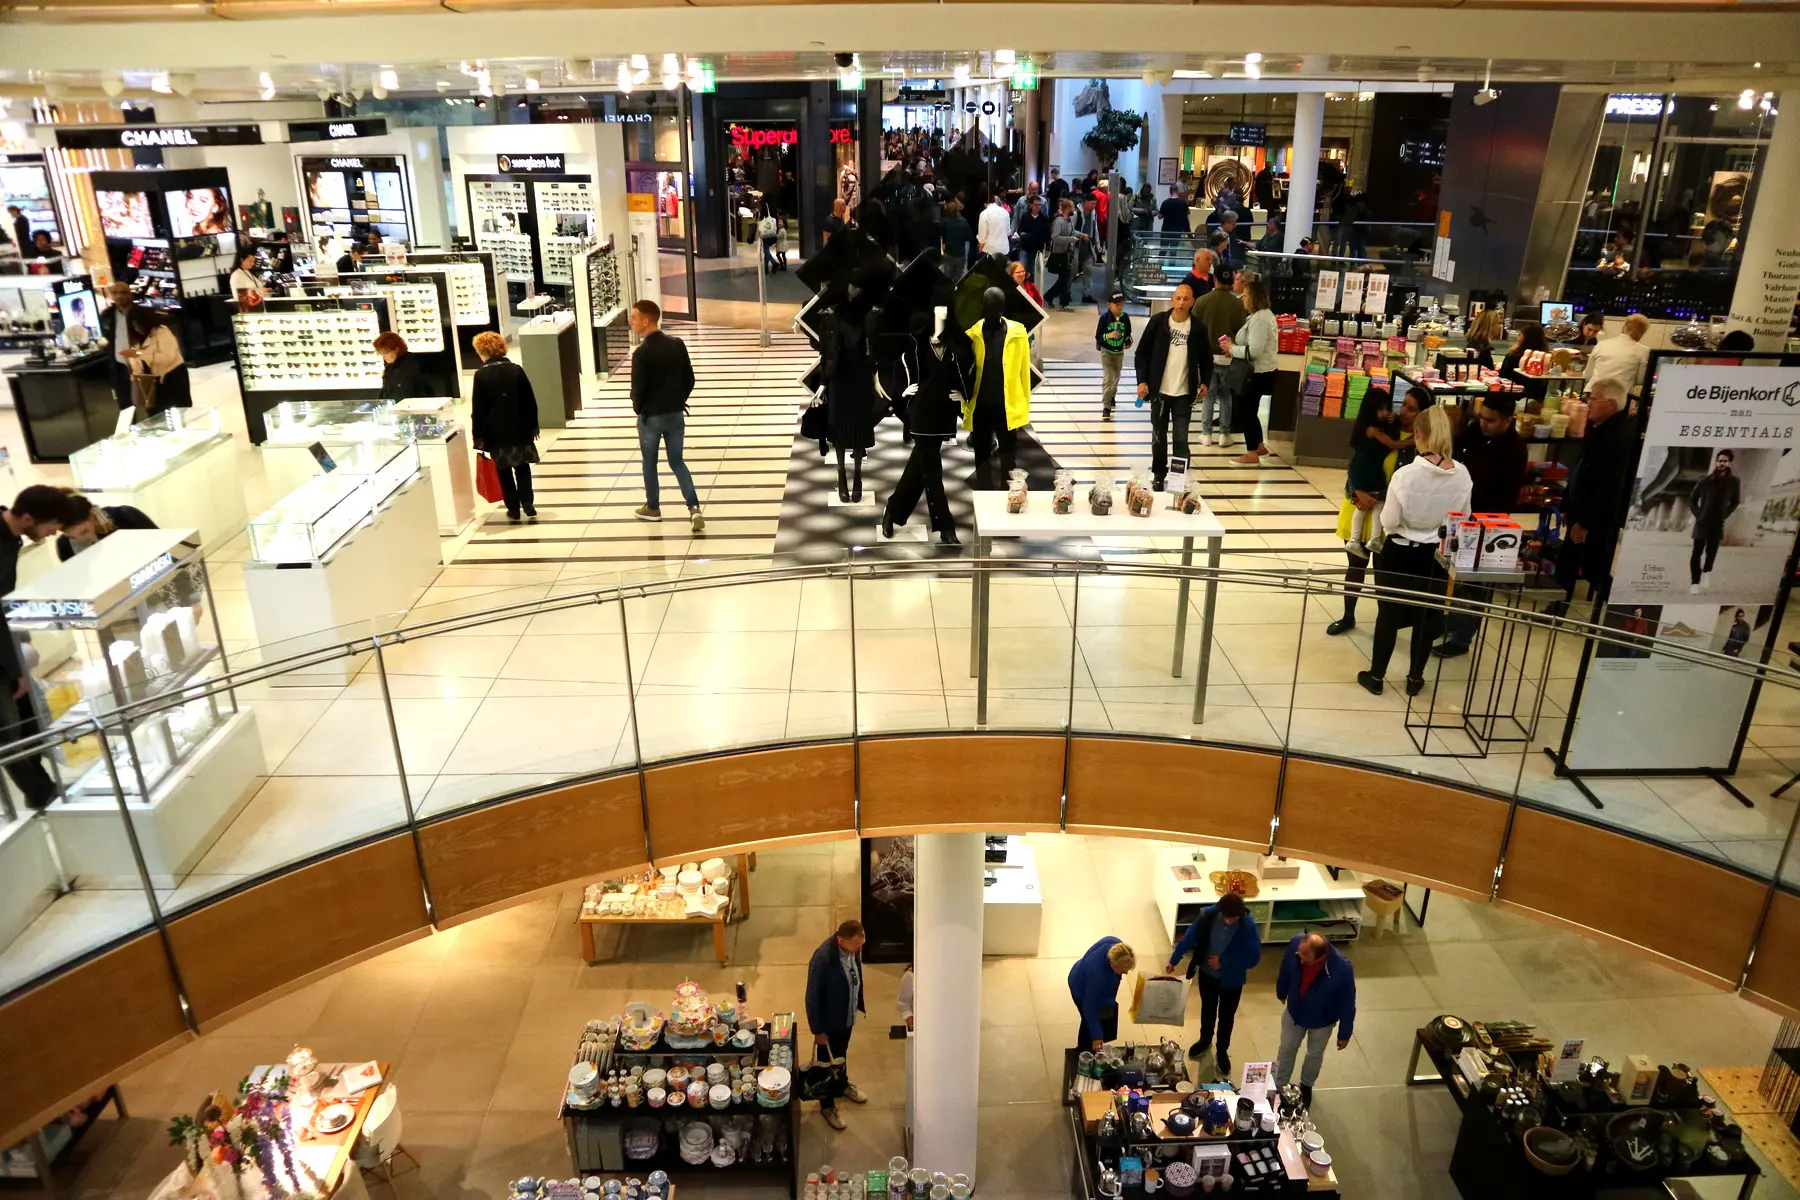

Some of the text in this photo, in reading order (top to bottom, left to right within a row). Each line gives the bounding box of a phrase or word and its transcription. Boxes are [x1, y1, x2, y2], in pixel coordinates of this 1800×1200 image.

[327, 123, 358, 137] CHANEL
[121, 129, 198, 147] CHANEL
[731, 126, 798, 150] Superd
[330, 158, 363, 168] CHANEL
[511, 155, 561, 171] sunglass hut
[1686, 385, 1782, 403] de Bijenkorf
[1730, 409, 1752, 417] man
[1679, 425, 1794, 439] ESSENTIALS
